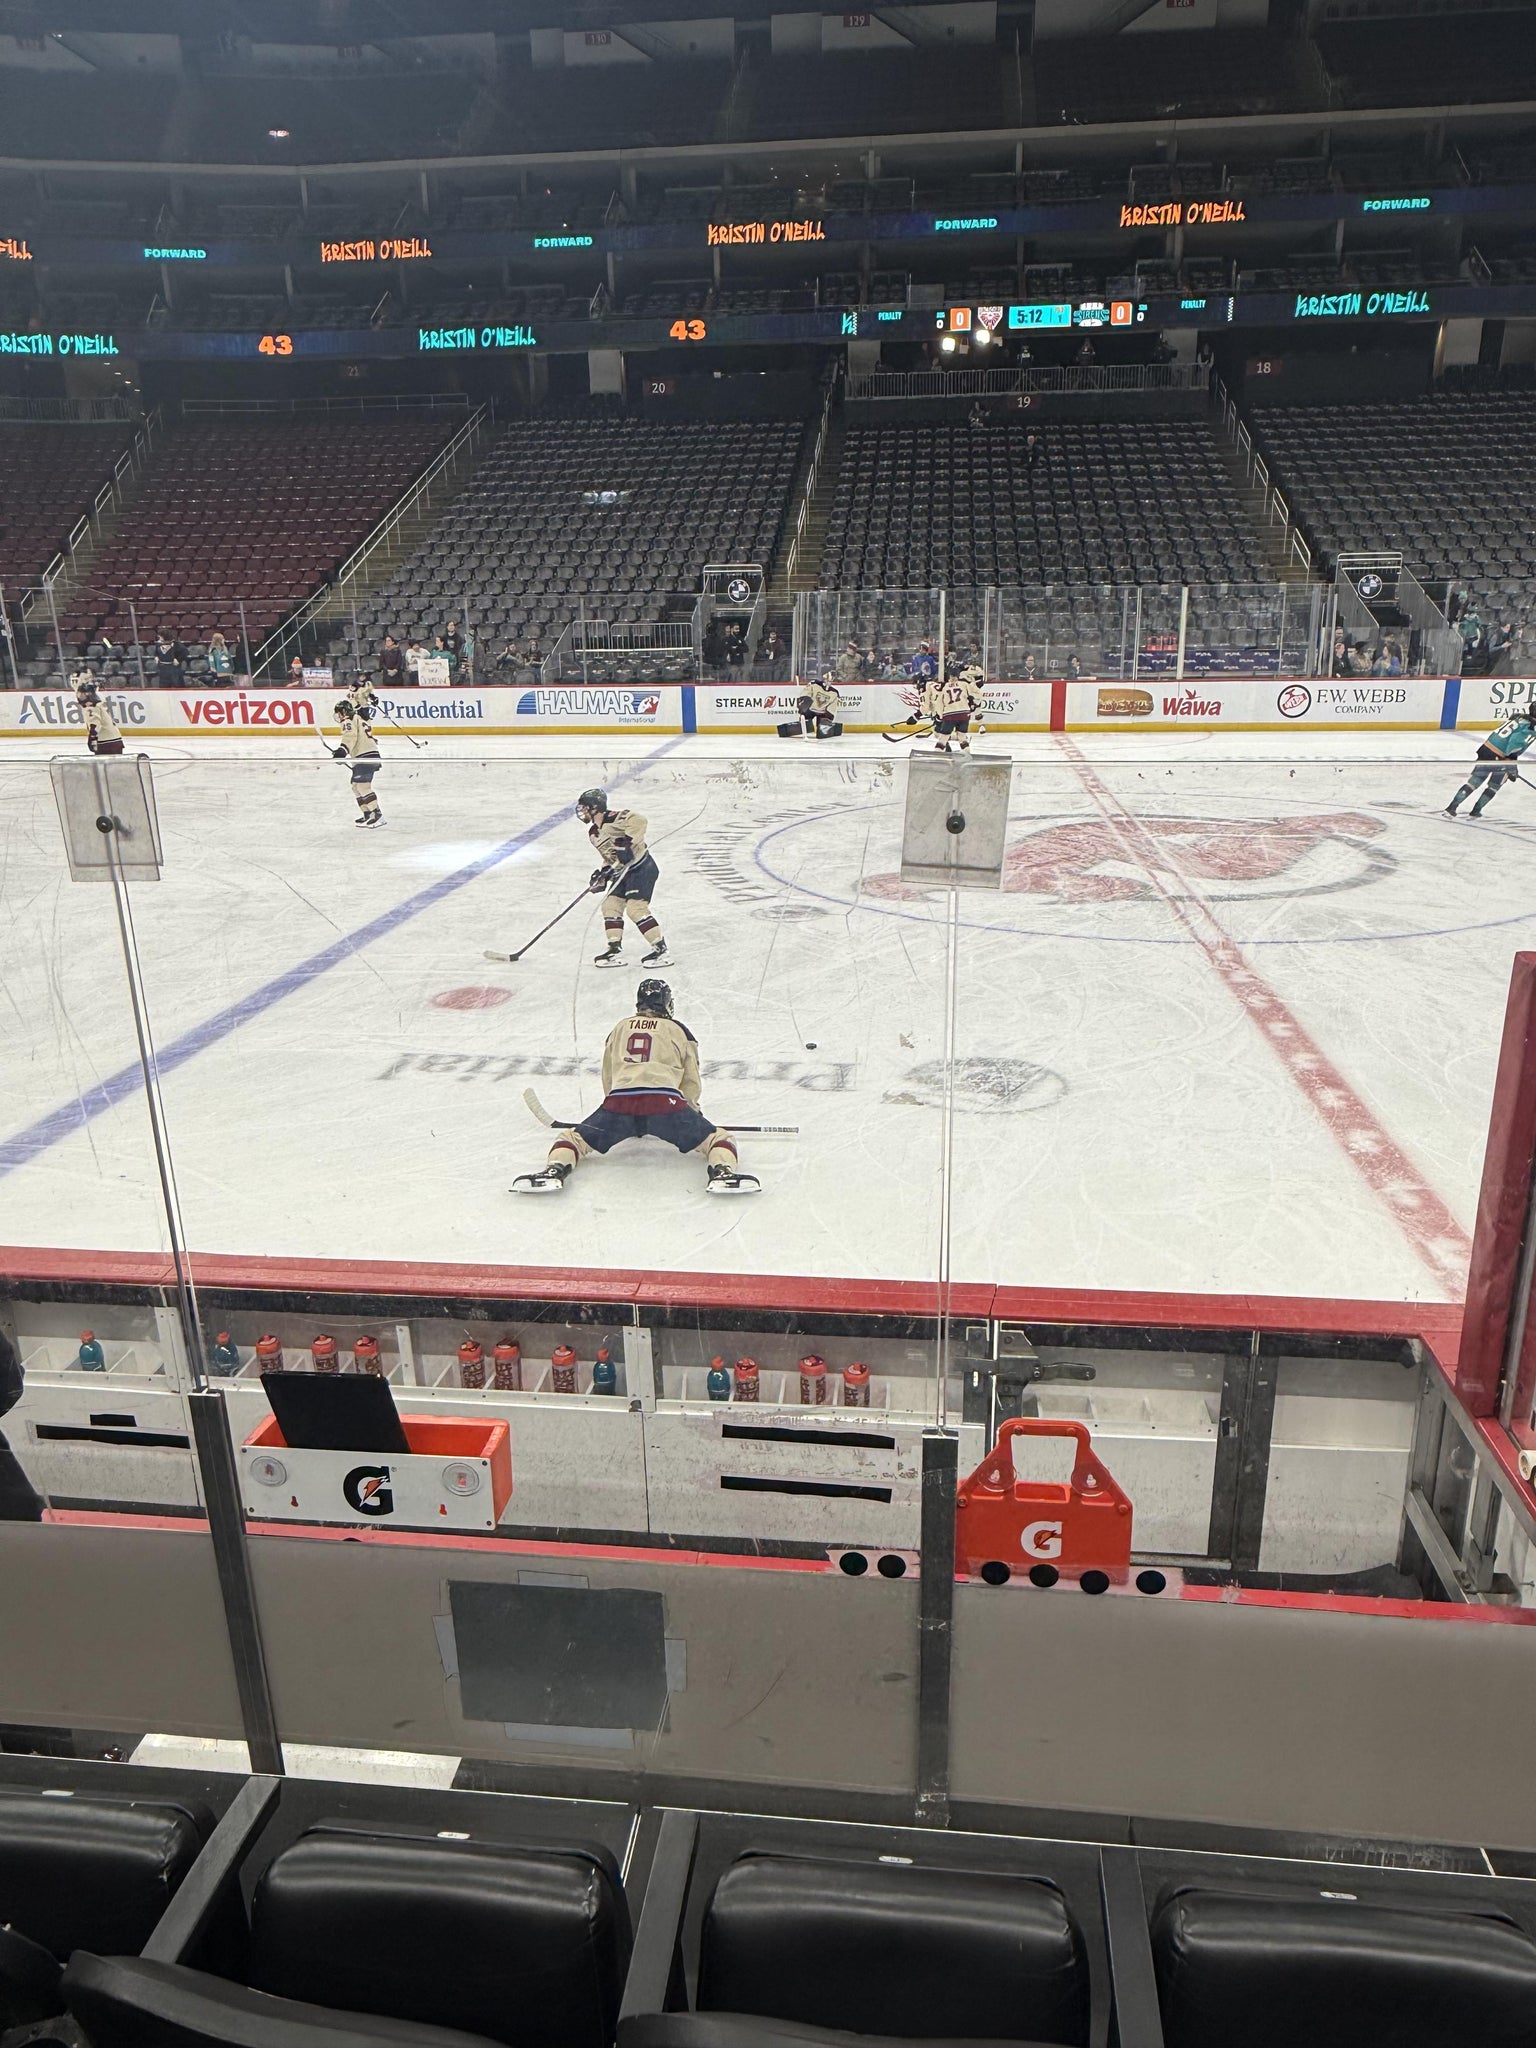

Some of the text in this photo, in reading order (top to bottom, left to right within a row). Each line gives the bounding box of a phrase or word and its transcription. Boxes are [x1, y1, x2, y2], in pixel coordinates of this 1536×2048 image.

[1119, 200, 1246, 227] KRISTIN O'NEILL
[1363, 198, 1431, 211] FORWARD
[707, 220, 825, 245] KRISTIN O'NEILL
[934, 218, 998, 231] FORWARD
[321, 239, 432, 262] KRISTIN O'NEILL
[533, 236, 593, 249] FORWARD
[144, 247, 207, 259] FORWARD
[1116, 305, 1124, 320] 0
[1294, 291, 1430, 318] KRISTIN O'NEILL
[956, 311, 964, 326] 0
[1017, 309, 1043, 324] 5:12
[419, 325, 537, 350] KRISTIN O'NEILL
[669, 319, 706, 341] 43
[58, 334, 119, 355] O'NEILL
[258, 334, 293, 356] 43
[1256, 361, 1272, 374] 18
[651, 382, 667, 394] 20
[1017, 396, 1031, 408] 19
[537, 690, 635, 715] HALMAR
[715, 697, 799, 708] STREAM LIV
[1316, 689, 1407, 703] F.W. WEBB
[19, 695, 146, 725] Atlatic
[180, 693, 315, 725] verizon
[381, 700, 484, 719] Prudential
[1162, 697, 1222, 716] Wawa
[1334, 705, 1384, 715] COMPANY
[629, 1019, 659, 1030] TABIN
[623, 1032, 653, 1064] 9
[375, 1052, 856, 1092] Pruntial
[342, 1465, 394, 1516] G
[1020, 1521, 1063, 1559] G
